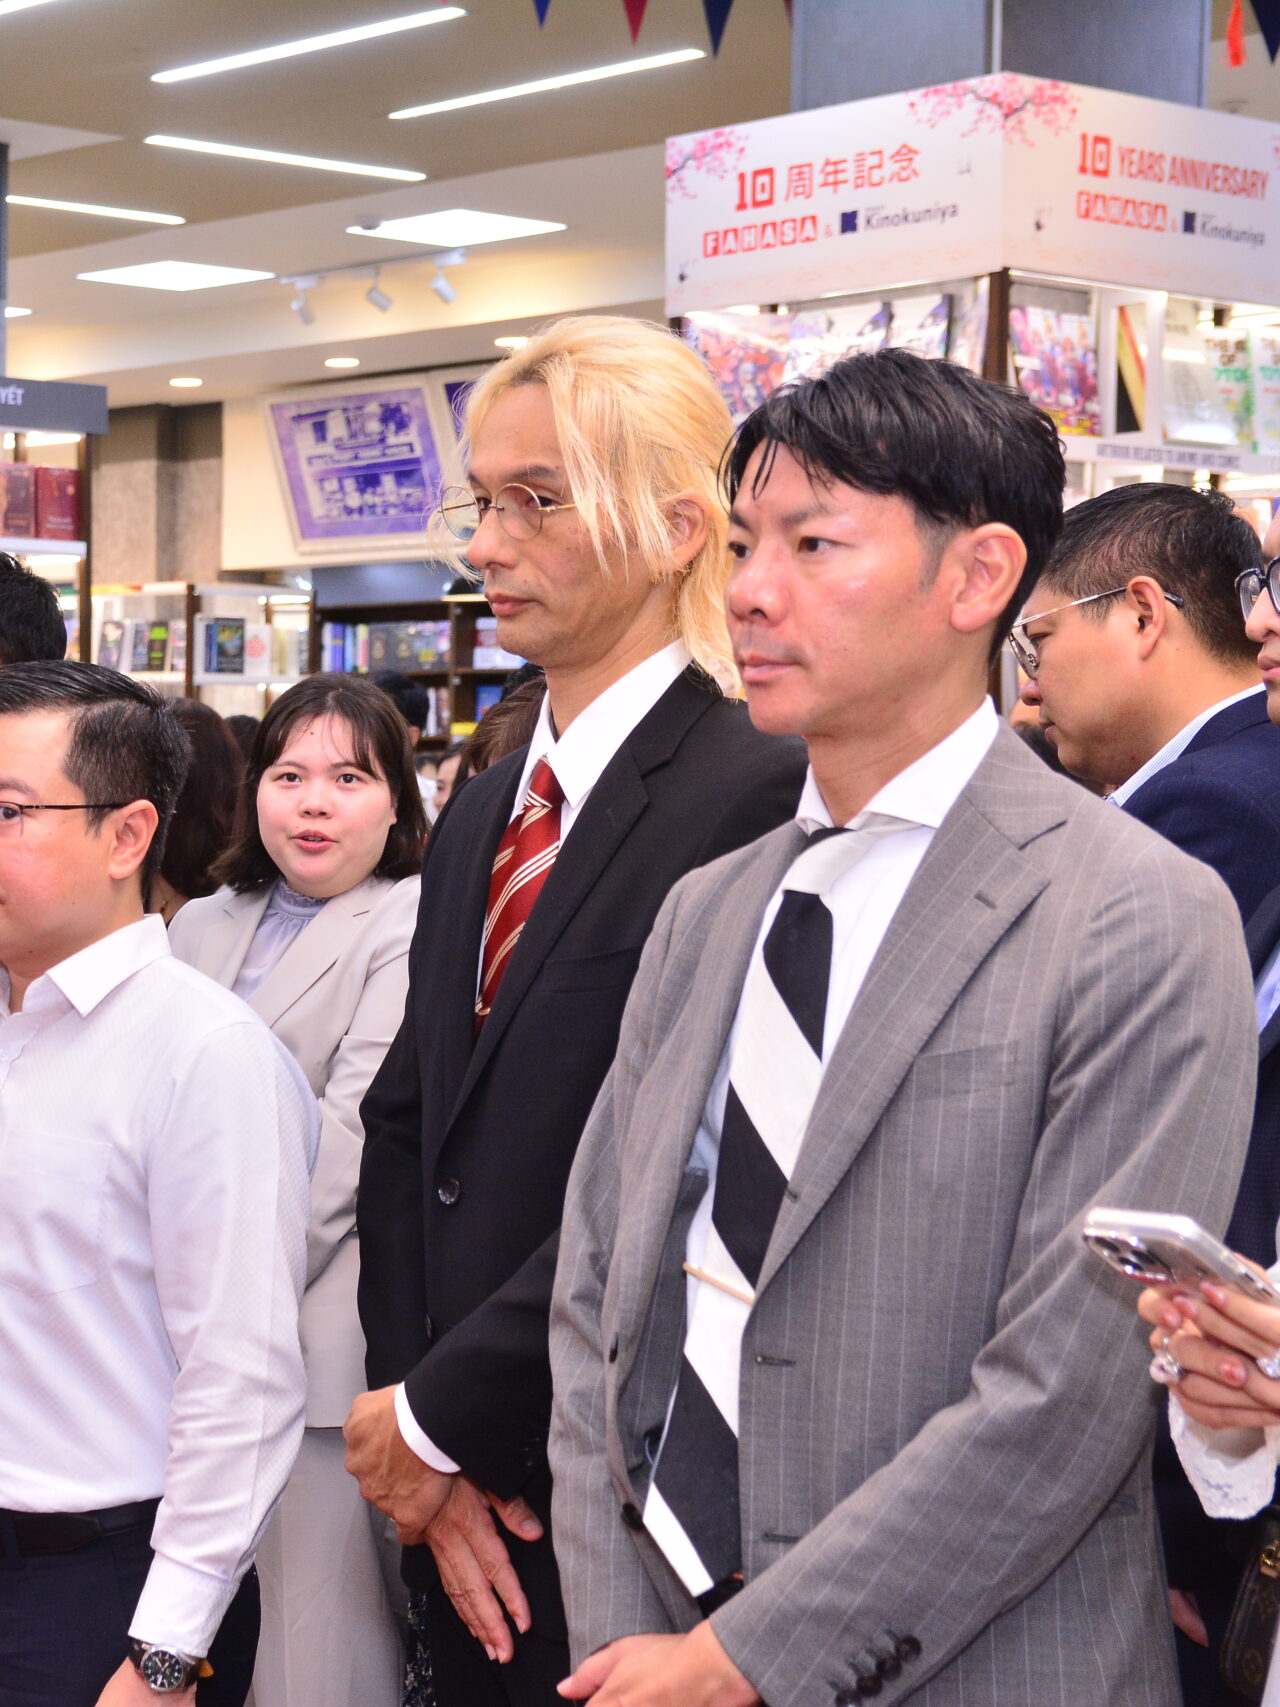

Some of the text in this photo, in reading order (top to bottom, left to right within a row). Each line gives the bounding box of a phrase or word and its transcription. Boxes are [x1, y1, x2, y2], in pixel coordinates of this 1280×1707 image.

[735, 143, 920, 211] 10 周年記念
[1077, 133, 1269, 200] 10 YEARS ANNIVERSARY
[703, 214, 818, 259] FAHASA
[864, 201, 959, 231] Kinokuniya
[1077, 190, 1168, 232] FAHASA
[1200, 217, 1265, 248] Kinokuniya
